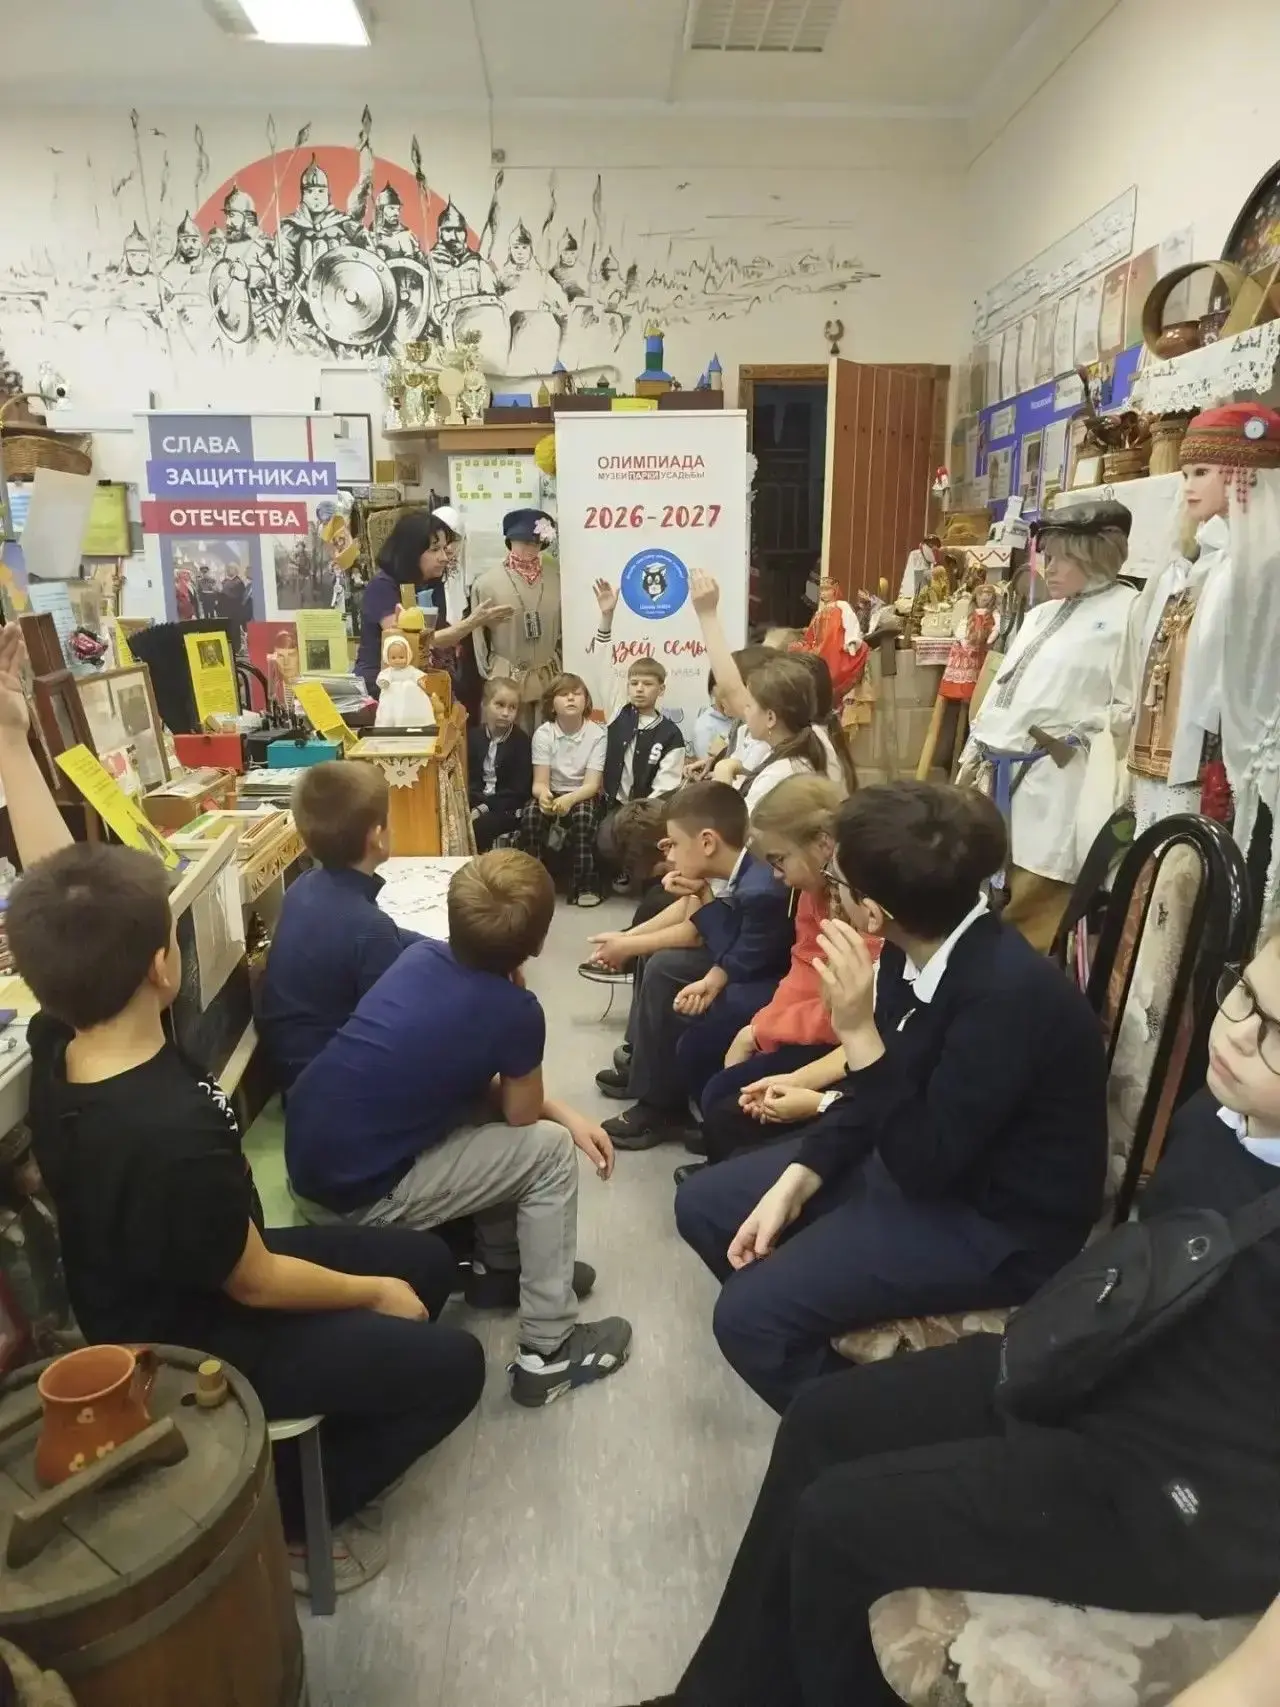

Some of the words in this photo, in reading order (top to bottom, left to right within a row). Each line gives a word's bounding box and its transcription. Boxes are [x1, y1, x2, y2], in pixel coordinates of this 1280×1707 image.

[161, 436, 240, 454] СЛАВА
[597, 455, 705, 470] ОЛИМПИАДА
[165, 467, 329, 489] ЗАЩИТНИКАМ
[660, 471, 705, 480] УСАДЬБЫ
[169, 508, 300, 527] ОТЕЧЕСТВА
[584, 504, 721, 529] 2026-2027
